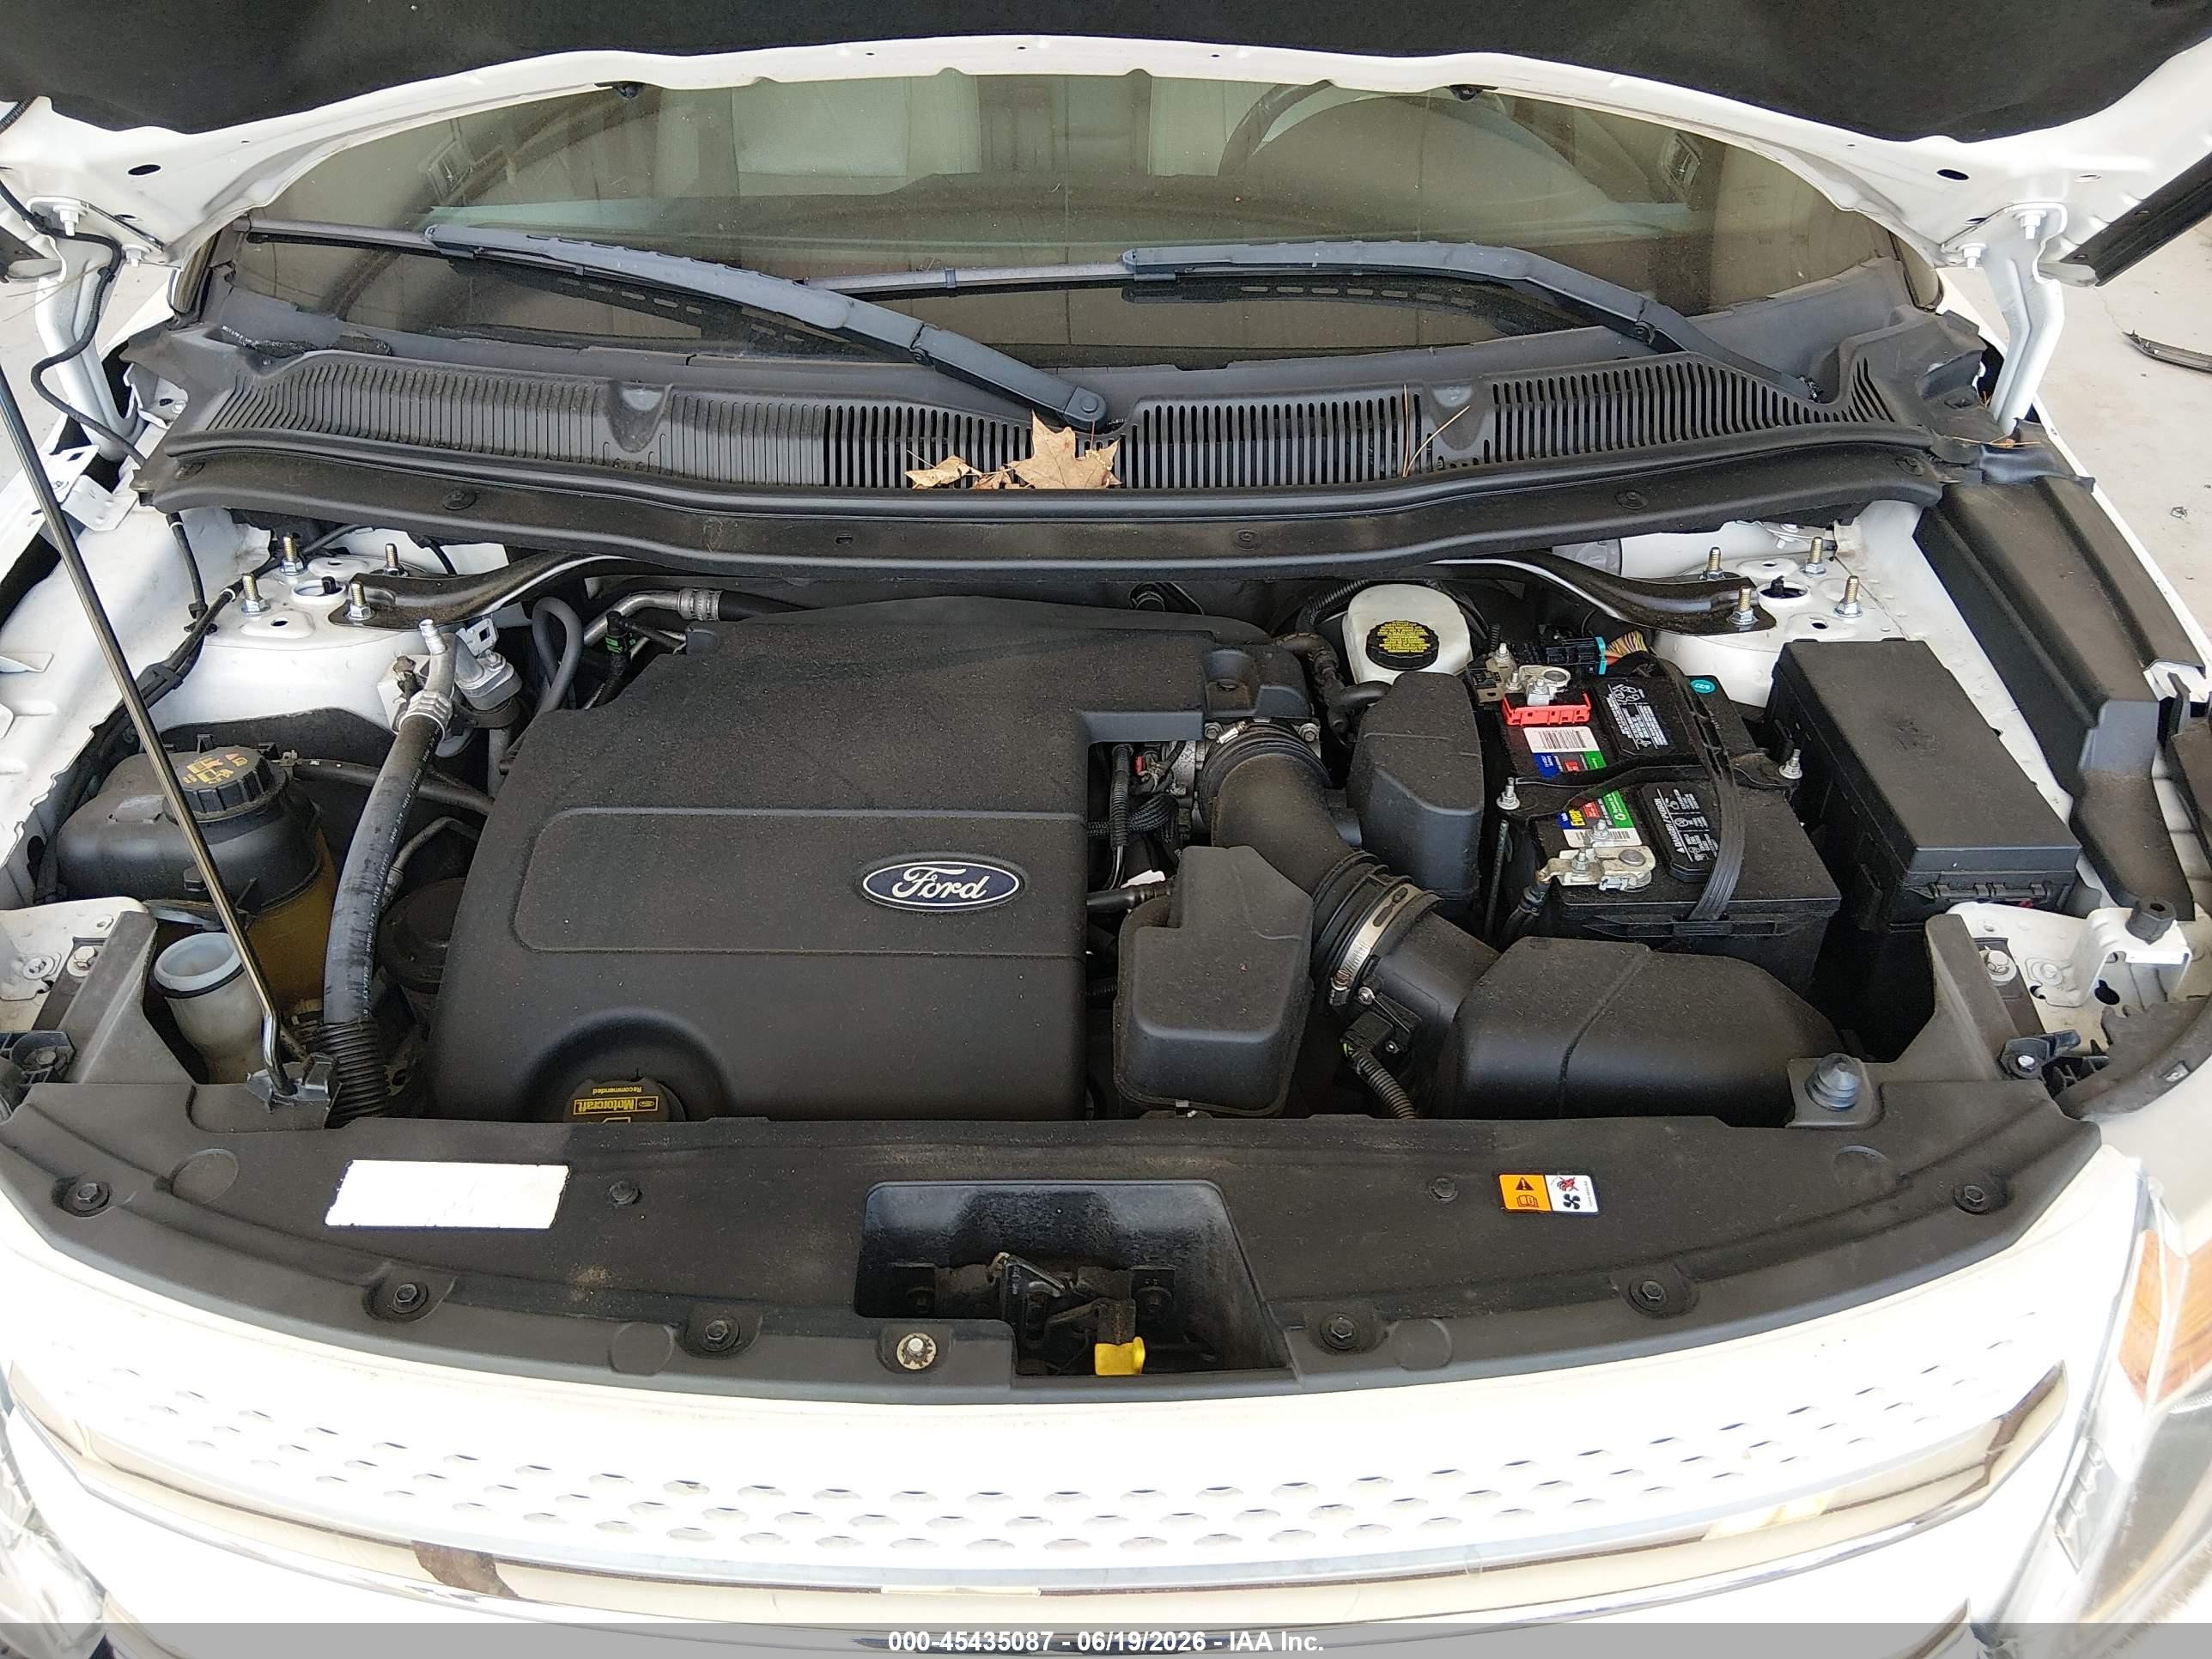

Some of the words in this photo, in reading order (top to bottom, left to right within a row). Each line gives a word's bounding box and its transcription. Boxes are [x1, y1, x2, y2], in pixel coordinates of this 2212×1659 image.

[1654, 798, 1670, 819] POISON
[1665, 823, 1683, 848] DANGER
[891, 866, 990, 899] Ford
[592, 1085, 642, 1096] Recommended
[575, 1098, 635, 1113] Motorcraft
